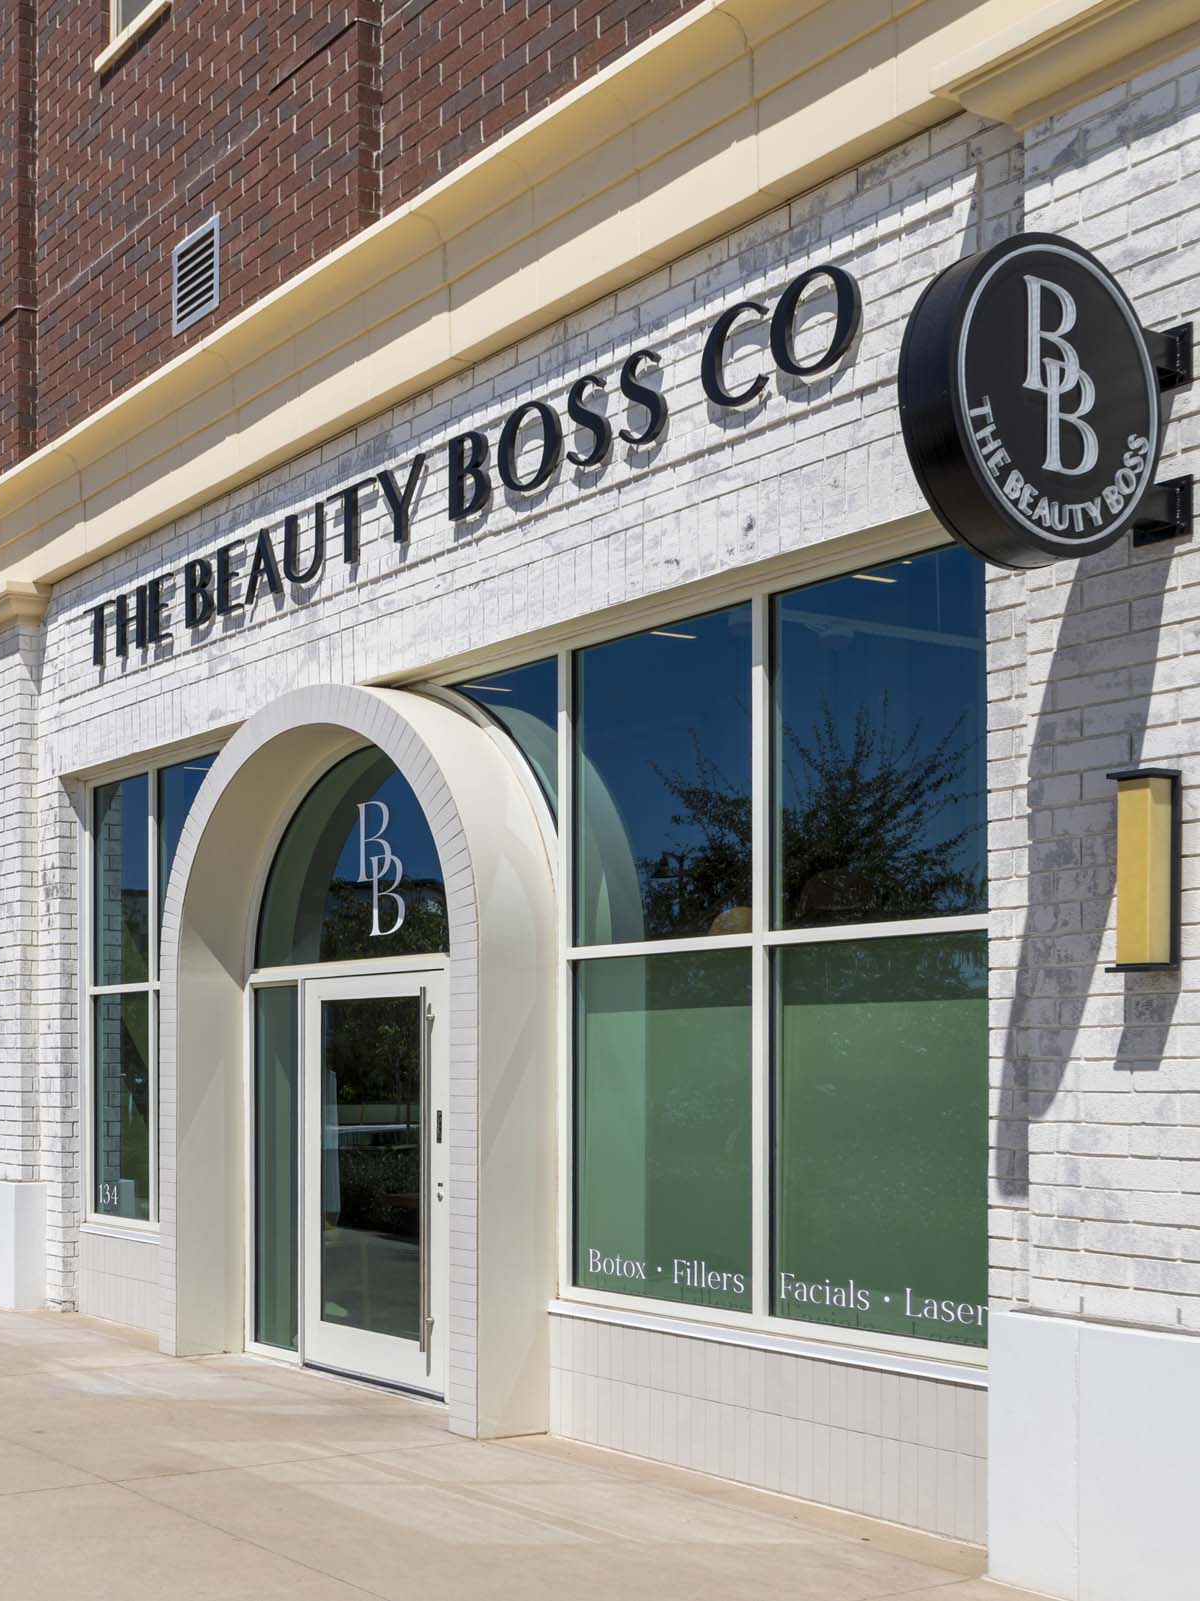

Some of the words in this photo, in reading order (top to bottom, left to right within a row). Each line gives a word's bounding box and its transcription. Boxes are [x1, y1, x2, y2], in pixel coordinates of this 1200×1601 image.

[83, 572, 174, 666] THE
[185, 453, 426, 629] BEAUTY
[448, 349, 668, 521] BOSS
[701, 265, 863, 408] CO
[968, 395, 1012, 477] THE
[1003, 469, 1104, 532] BEAUTY
[1100, 433, 1149, 514] BOSS
[98, 1183, 119, 1205] 134
[588, 1248, 647, 1280] Botox
[673, 1259, 745, 1294] Fillers
[779, 1272, 871, 1311] Facials
